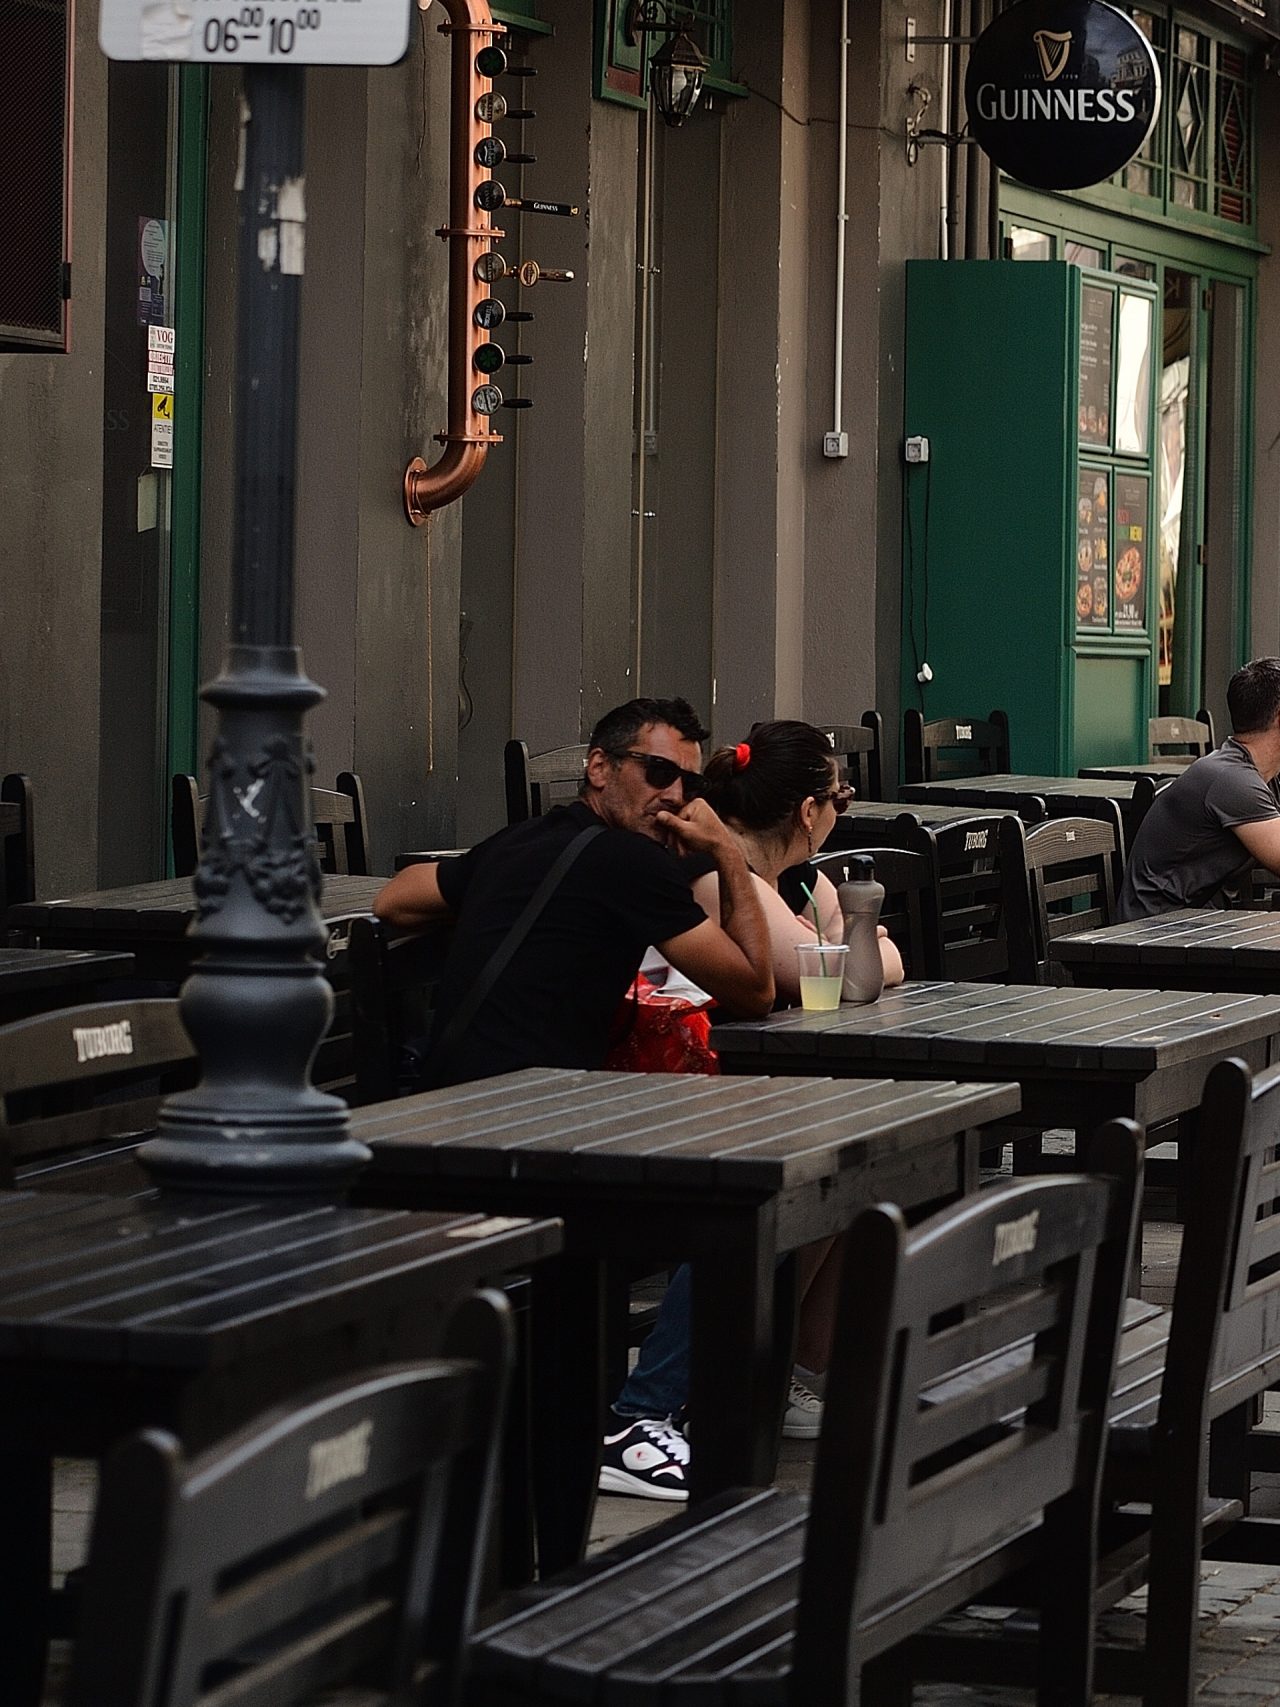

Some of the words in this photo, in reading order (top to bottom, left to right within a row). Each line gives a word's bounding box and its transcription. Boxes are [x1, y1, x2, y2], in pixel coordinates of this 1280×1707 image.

[976, 83, 1136, 122] GUINNESS
[533, 202, 559, 212] GUINNESS
[963, 828, 989, 852] TUBORG
[72, 1020, 134, 1063] TUBORG
